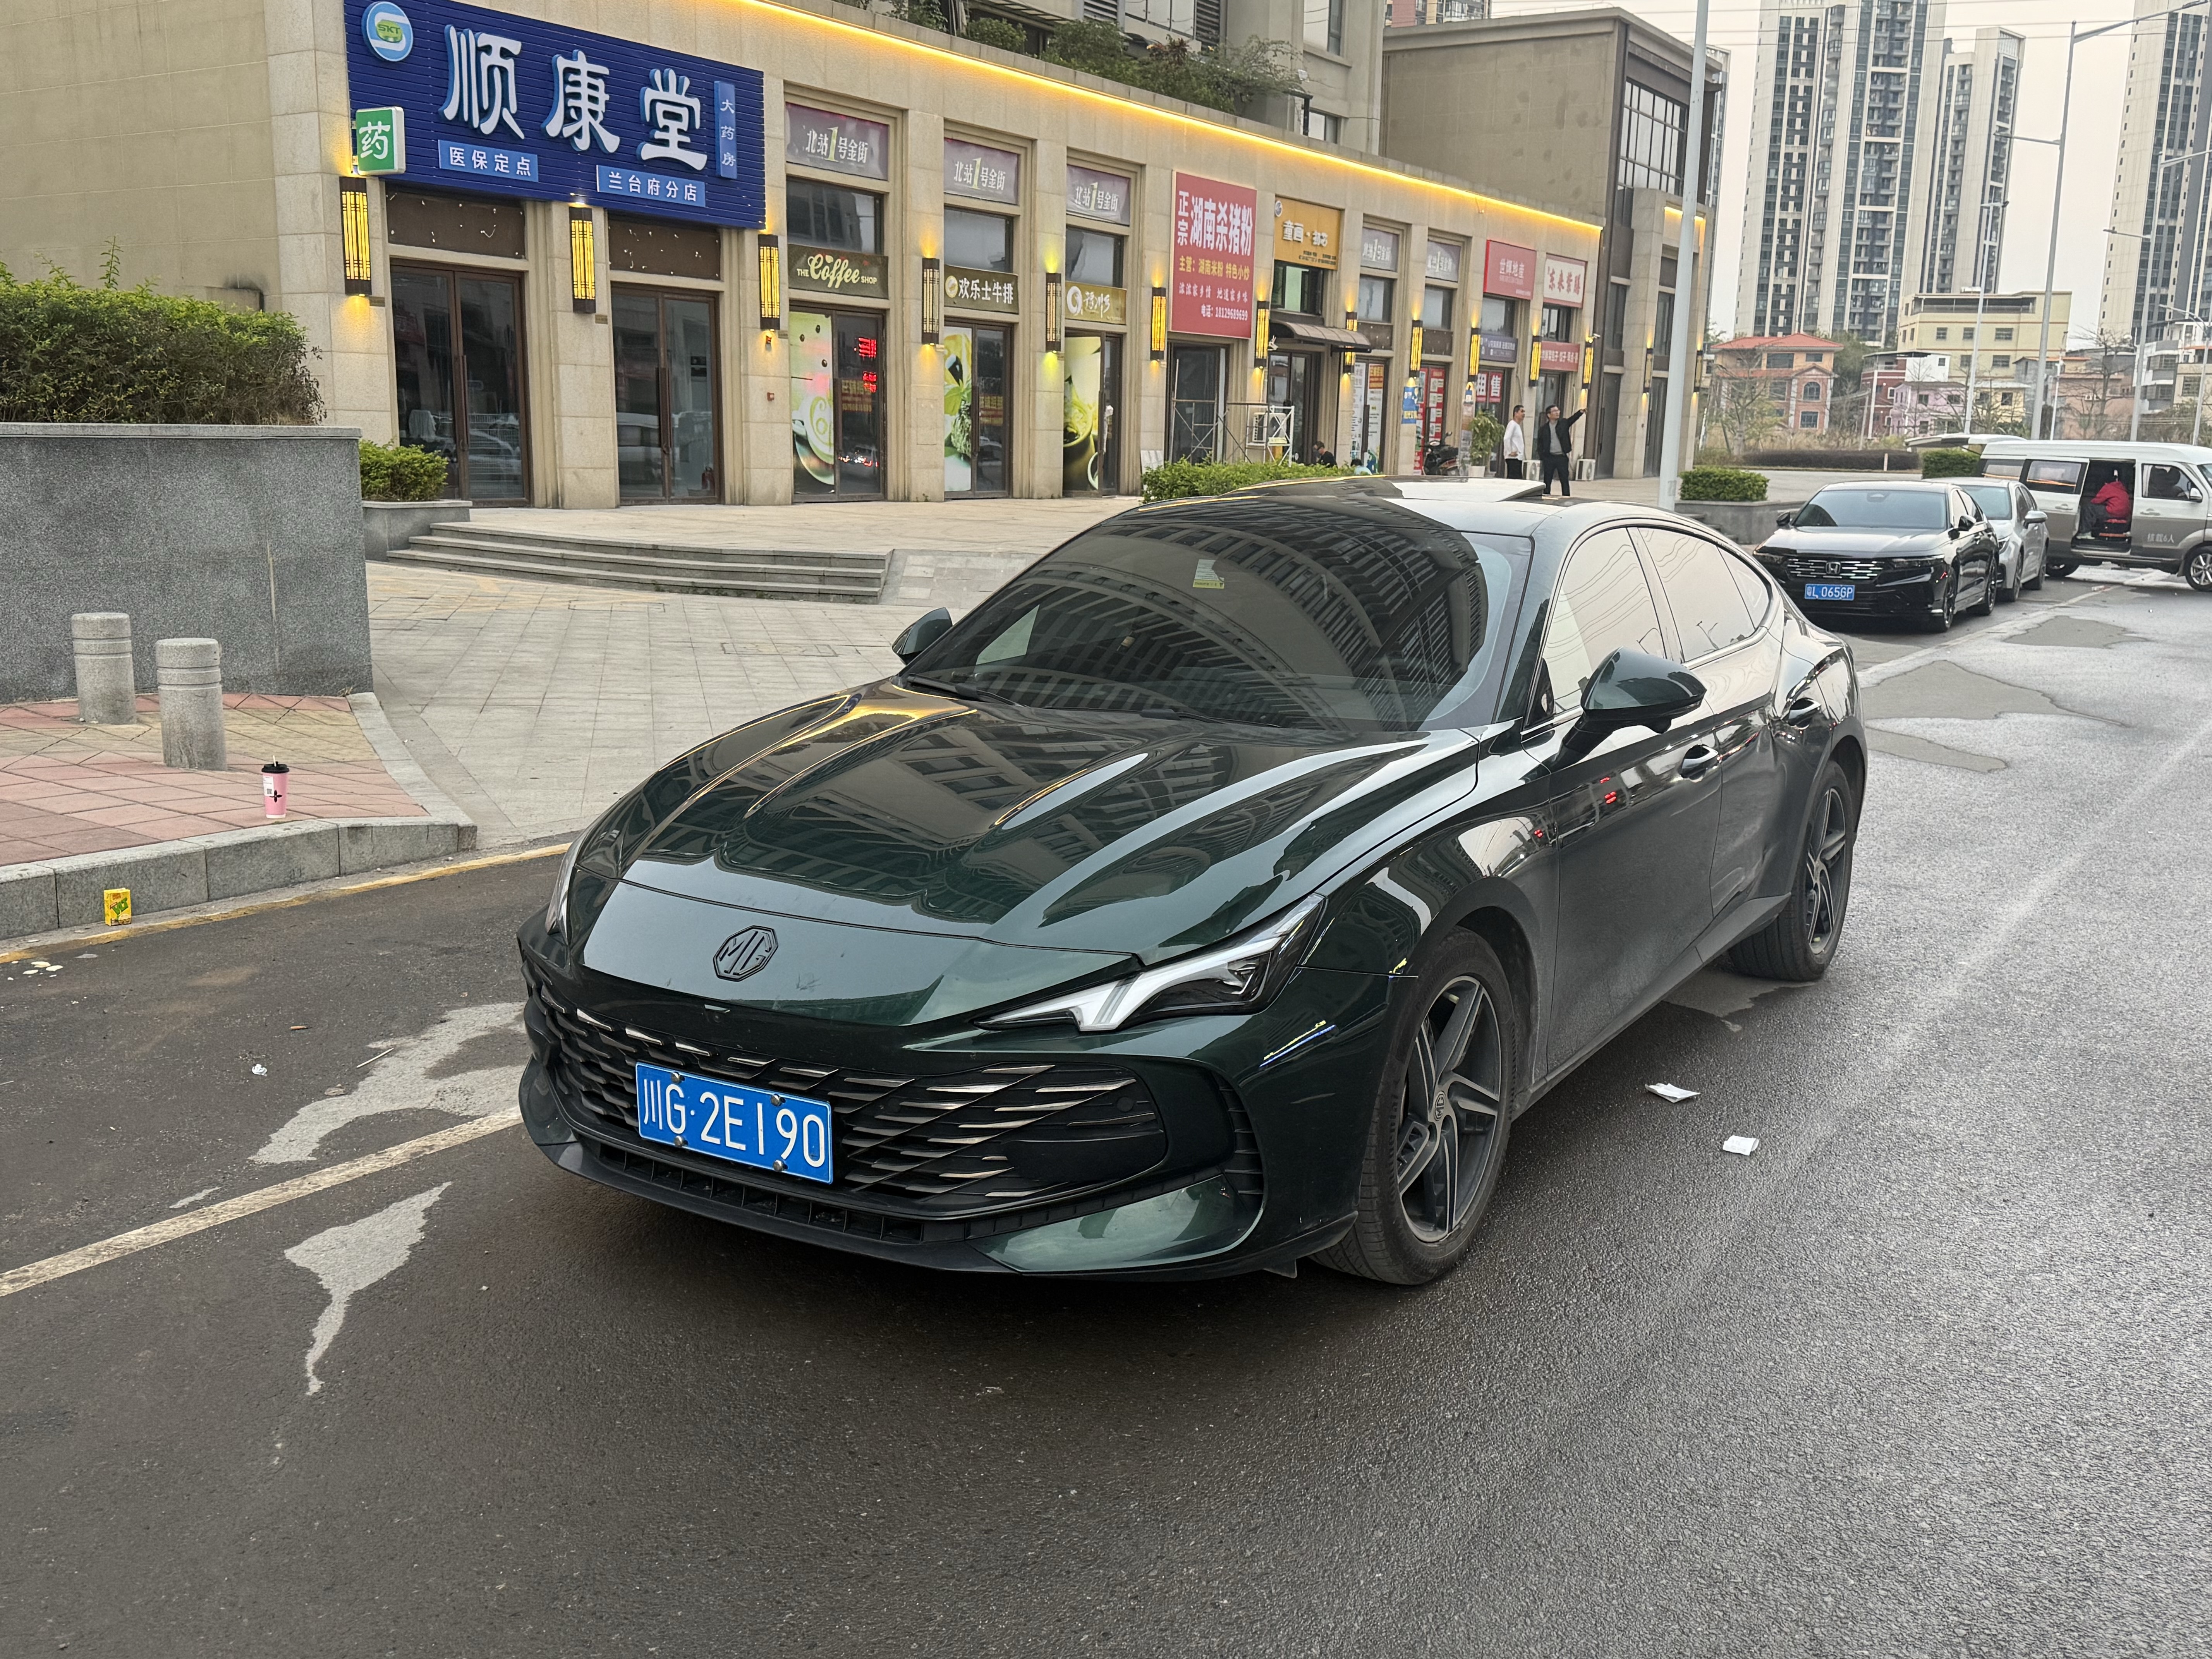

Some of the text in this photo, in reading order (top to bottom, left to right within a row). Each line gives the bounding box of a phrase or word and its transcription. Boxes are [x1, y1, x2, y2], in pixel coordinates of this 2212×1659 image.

[378, 24, 400, 34] SKT
[439, 24, 708, 171] 顺康堂
[359, 121, 390, 160] 药
[720, 98, 737, 168] 大药房
[805, 126, 868, 163] 北站1号金街
[449, 146, 531, 177] 医保定点
[954, 157, 1006, 191] 北站1号金街
[608, 171, 697, 203] 兰台府分店
[1074, 182, 1119, 211] 北站1号金街
[1177, 191, 1189, 246] 正宗
[1190, 195, 1253, 256] 湖南杀猪粉
[797, 254, 877, 289] THE Coffee SHOP
[1226, 262, 1250, 281] 特色小炒
[958, 278, 1014, 304] 欢乐士牛排
[1216, 287, 1248, 303] 地道家乡味
[717, 928, 776, 978] MG
[643, 1079, 826, 1168] 川G·2E190
